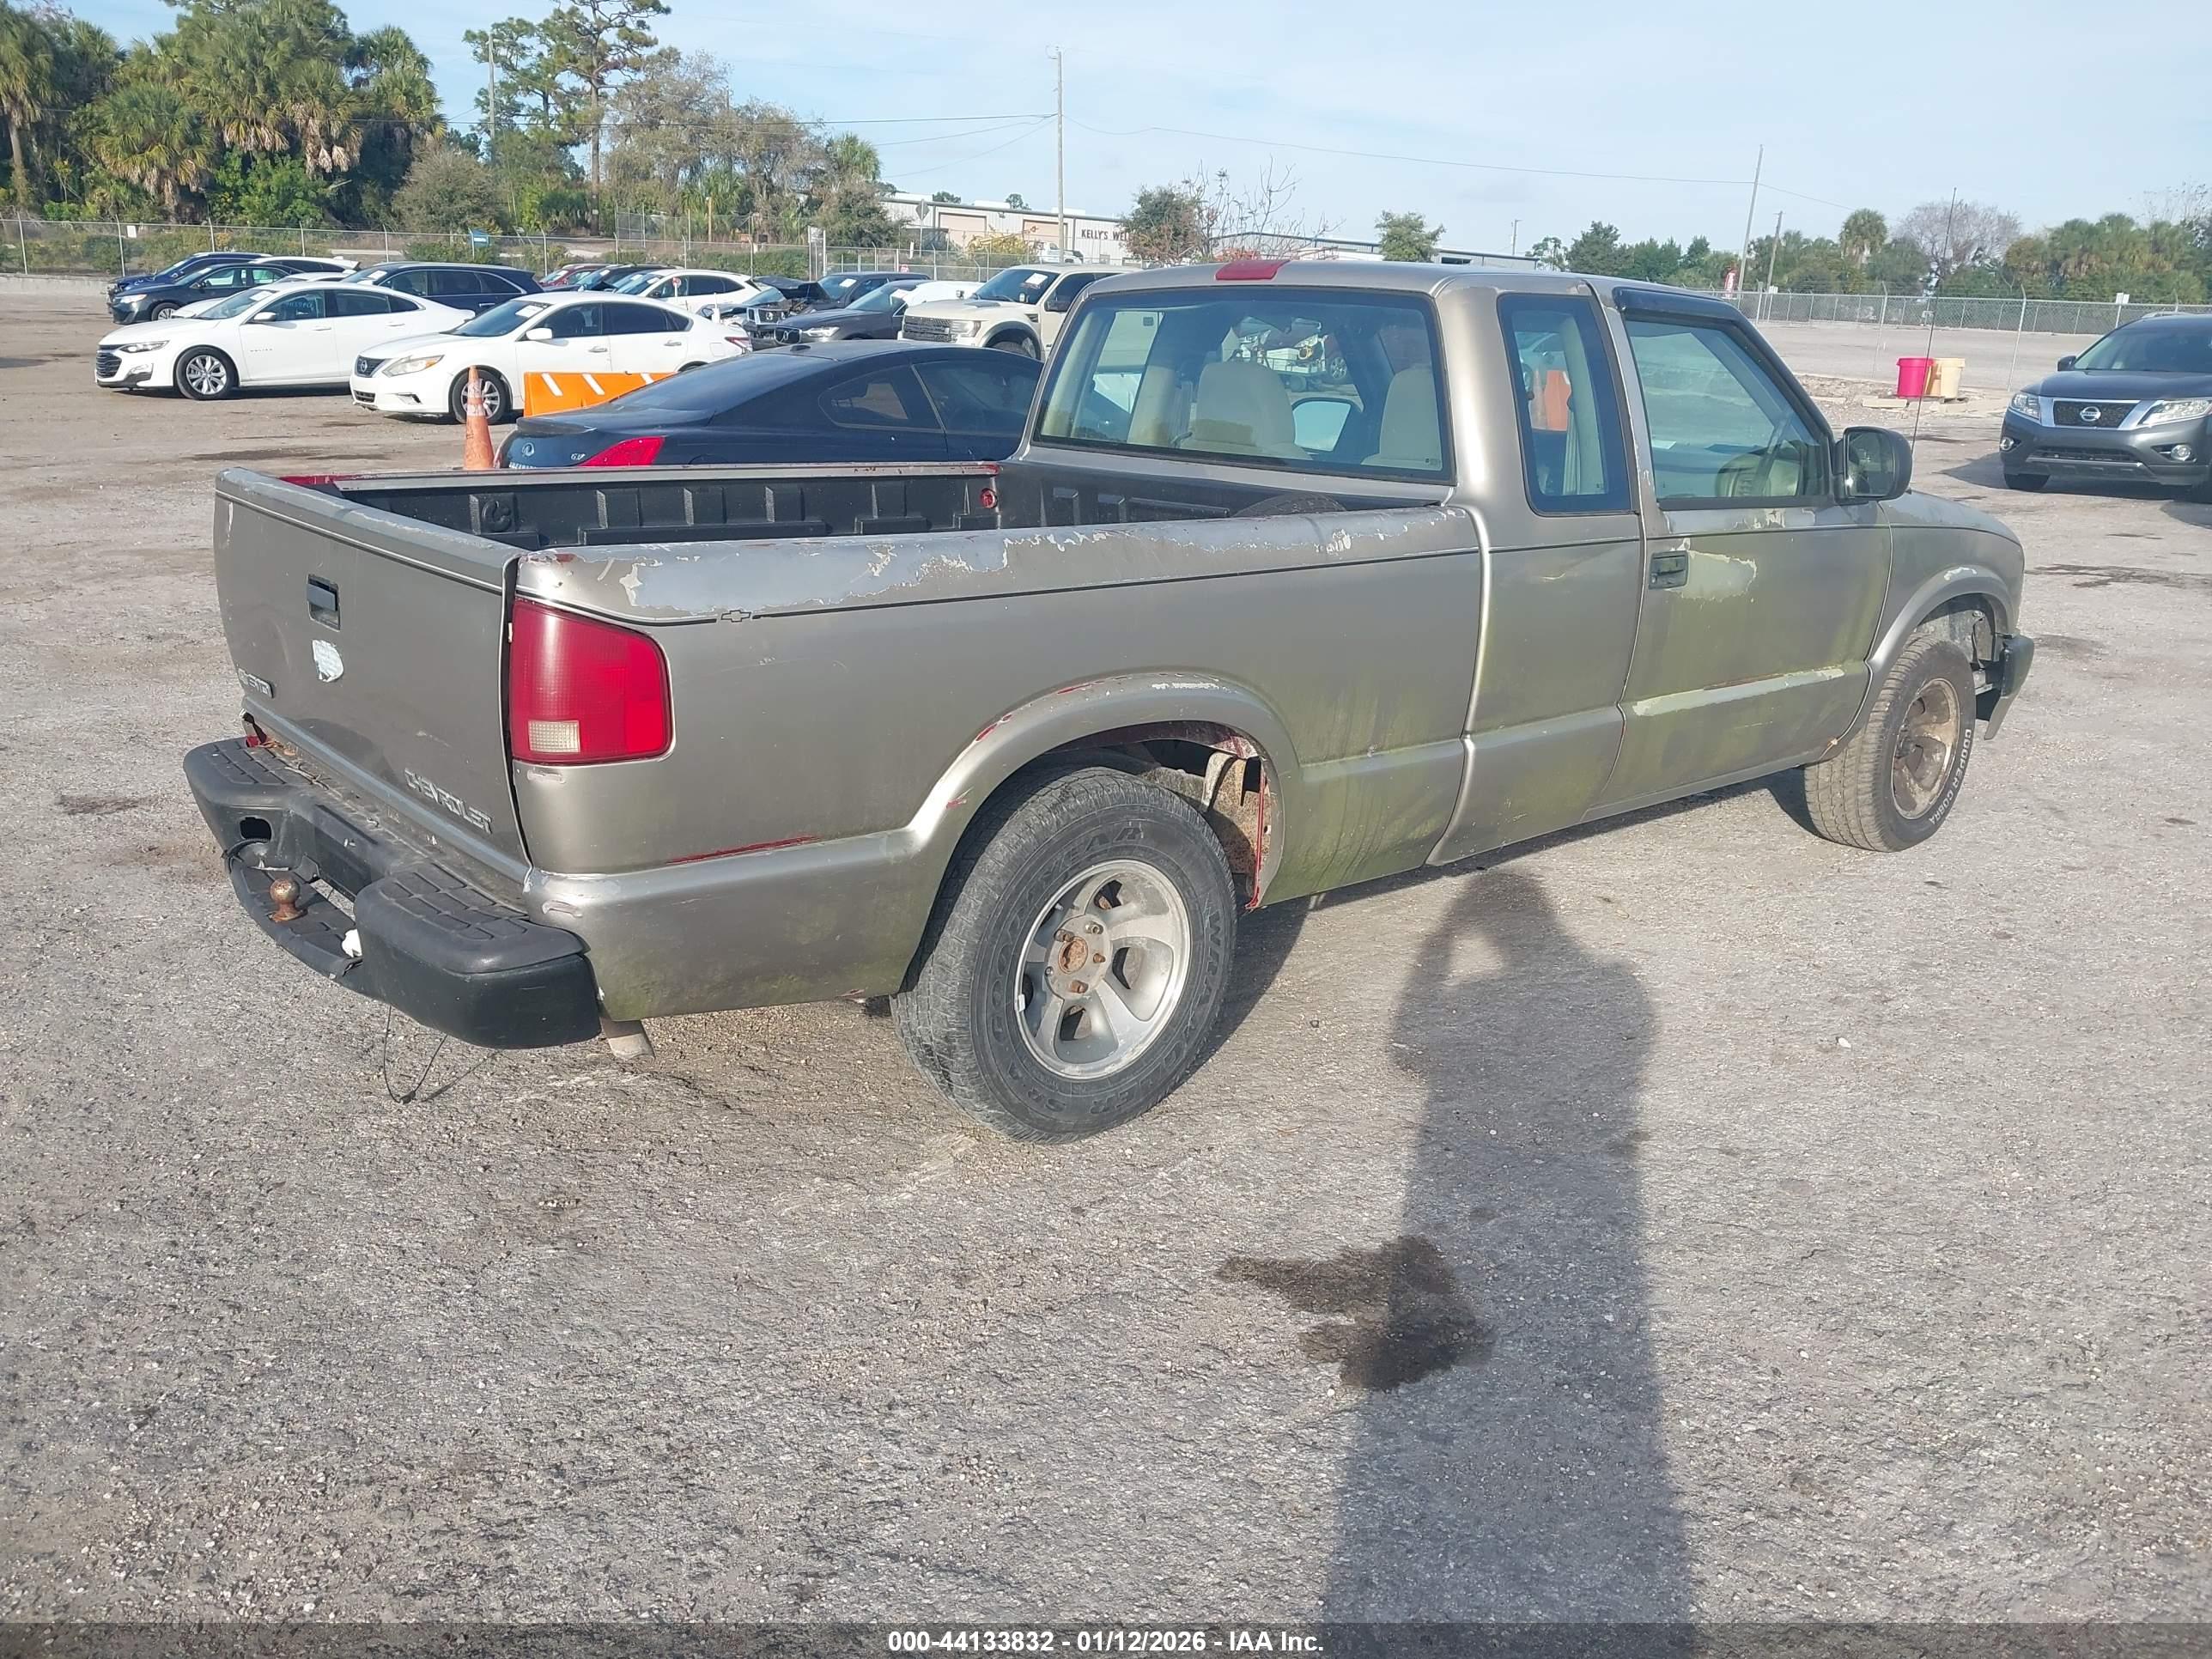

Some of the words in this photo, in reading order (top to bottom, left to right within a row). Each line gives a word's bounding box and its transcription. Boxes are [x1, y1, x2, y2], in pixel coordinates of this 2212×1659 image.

[1081, 228, 1109, 240] KELLY'S
[1952, 728, 1972, 789] COOPER
[404, 767, 493, 835] CHEVROLET
[1928, 789, 1954, 825] COBRA
